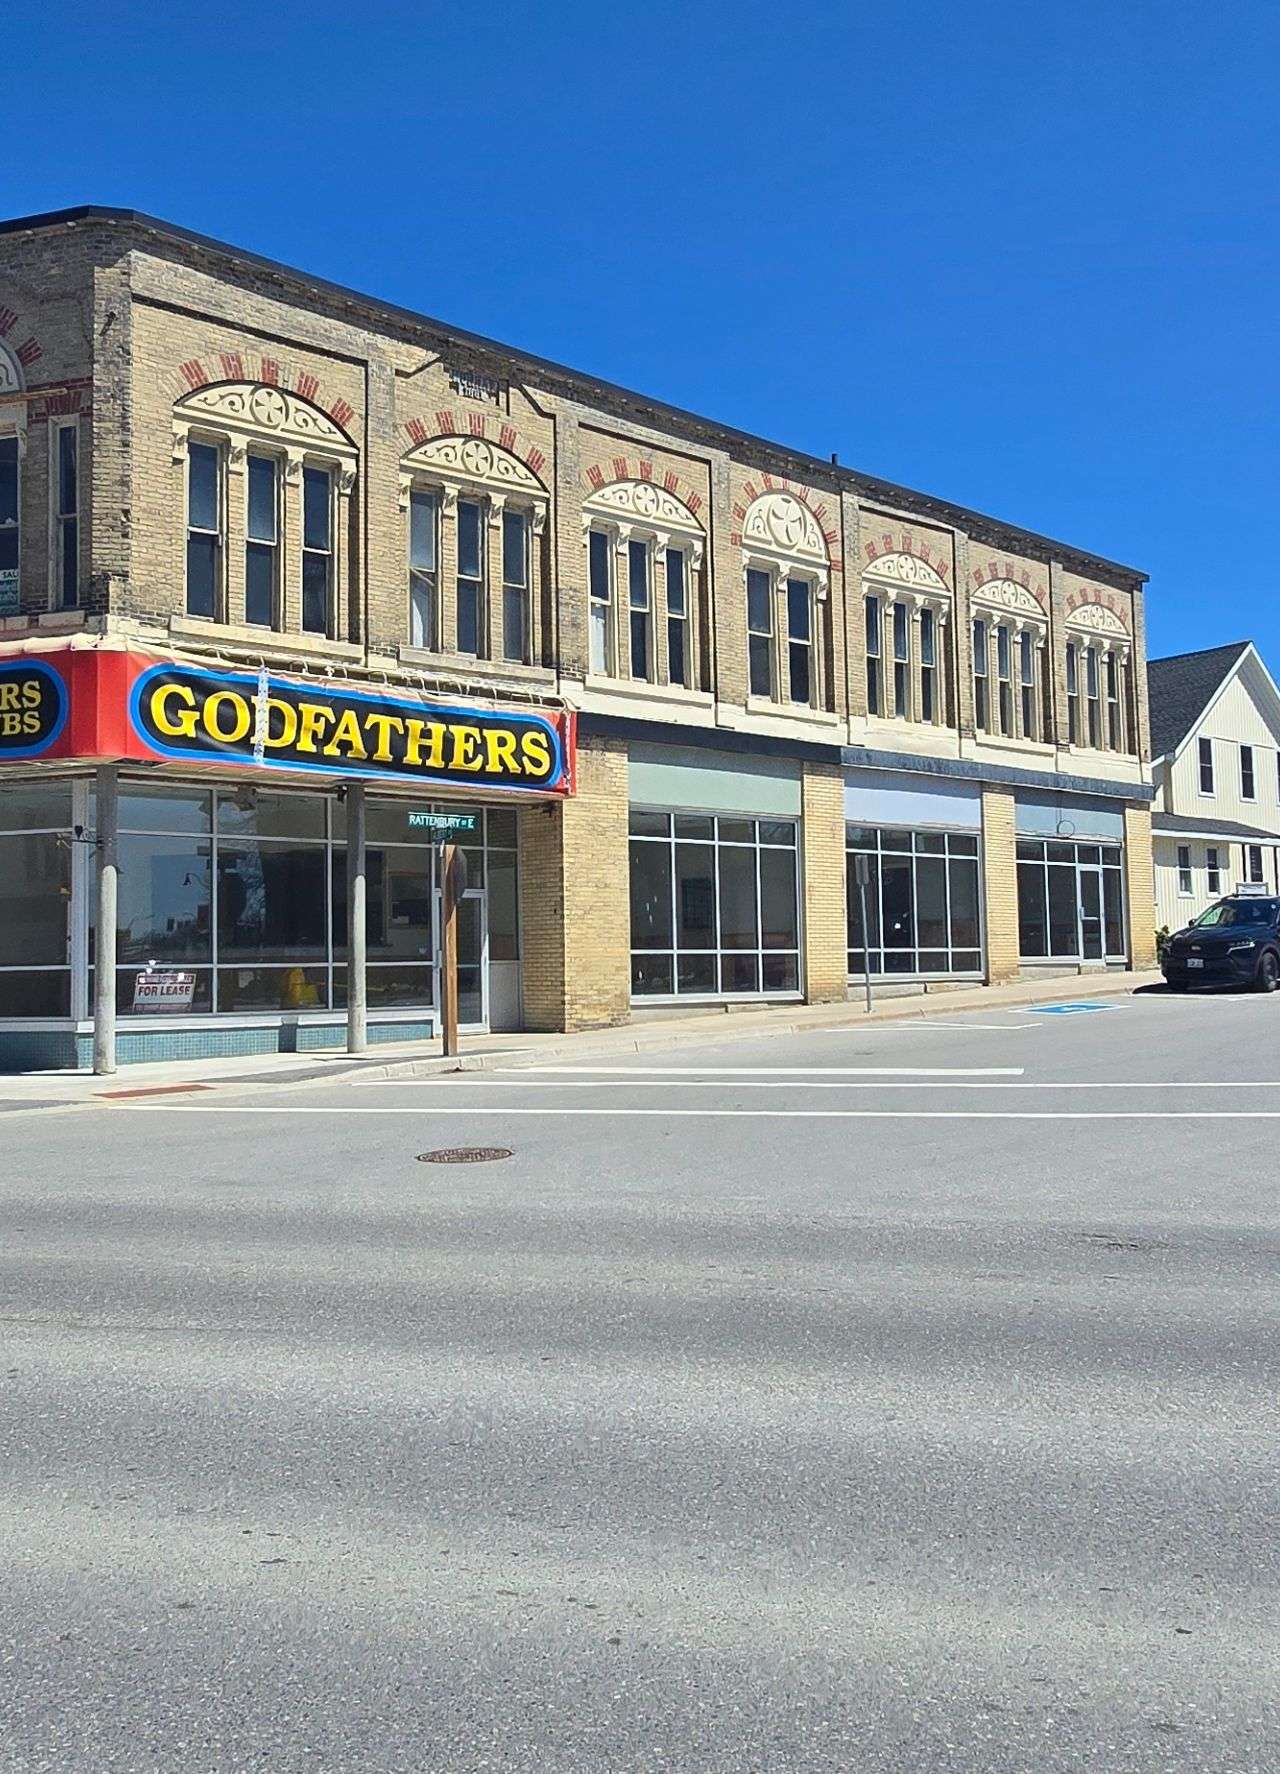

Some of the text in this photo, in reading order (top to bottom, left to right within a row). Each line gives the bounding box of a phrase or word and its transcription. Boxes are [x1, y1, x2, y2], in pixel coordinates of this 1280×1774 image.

[150, 683, 551, 777] GODFATHERS
[409, 815, 460, 828] RATTENBURY
[467, 818, 474, 828] E
[139, 986, 190, 996] FOR LEASE
